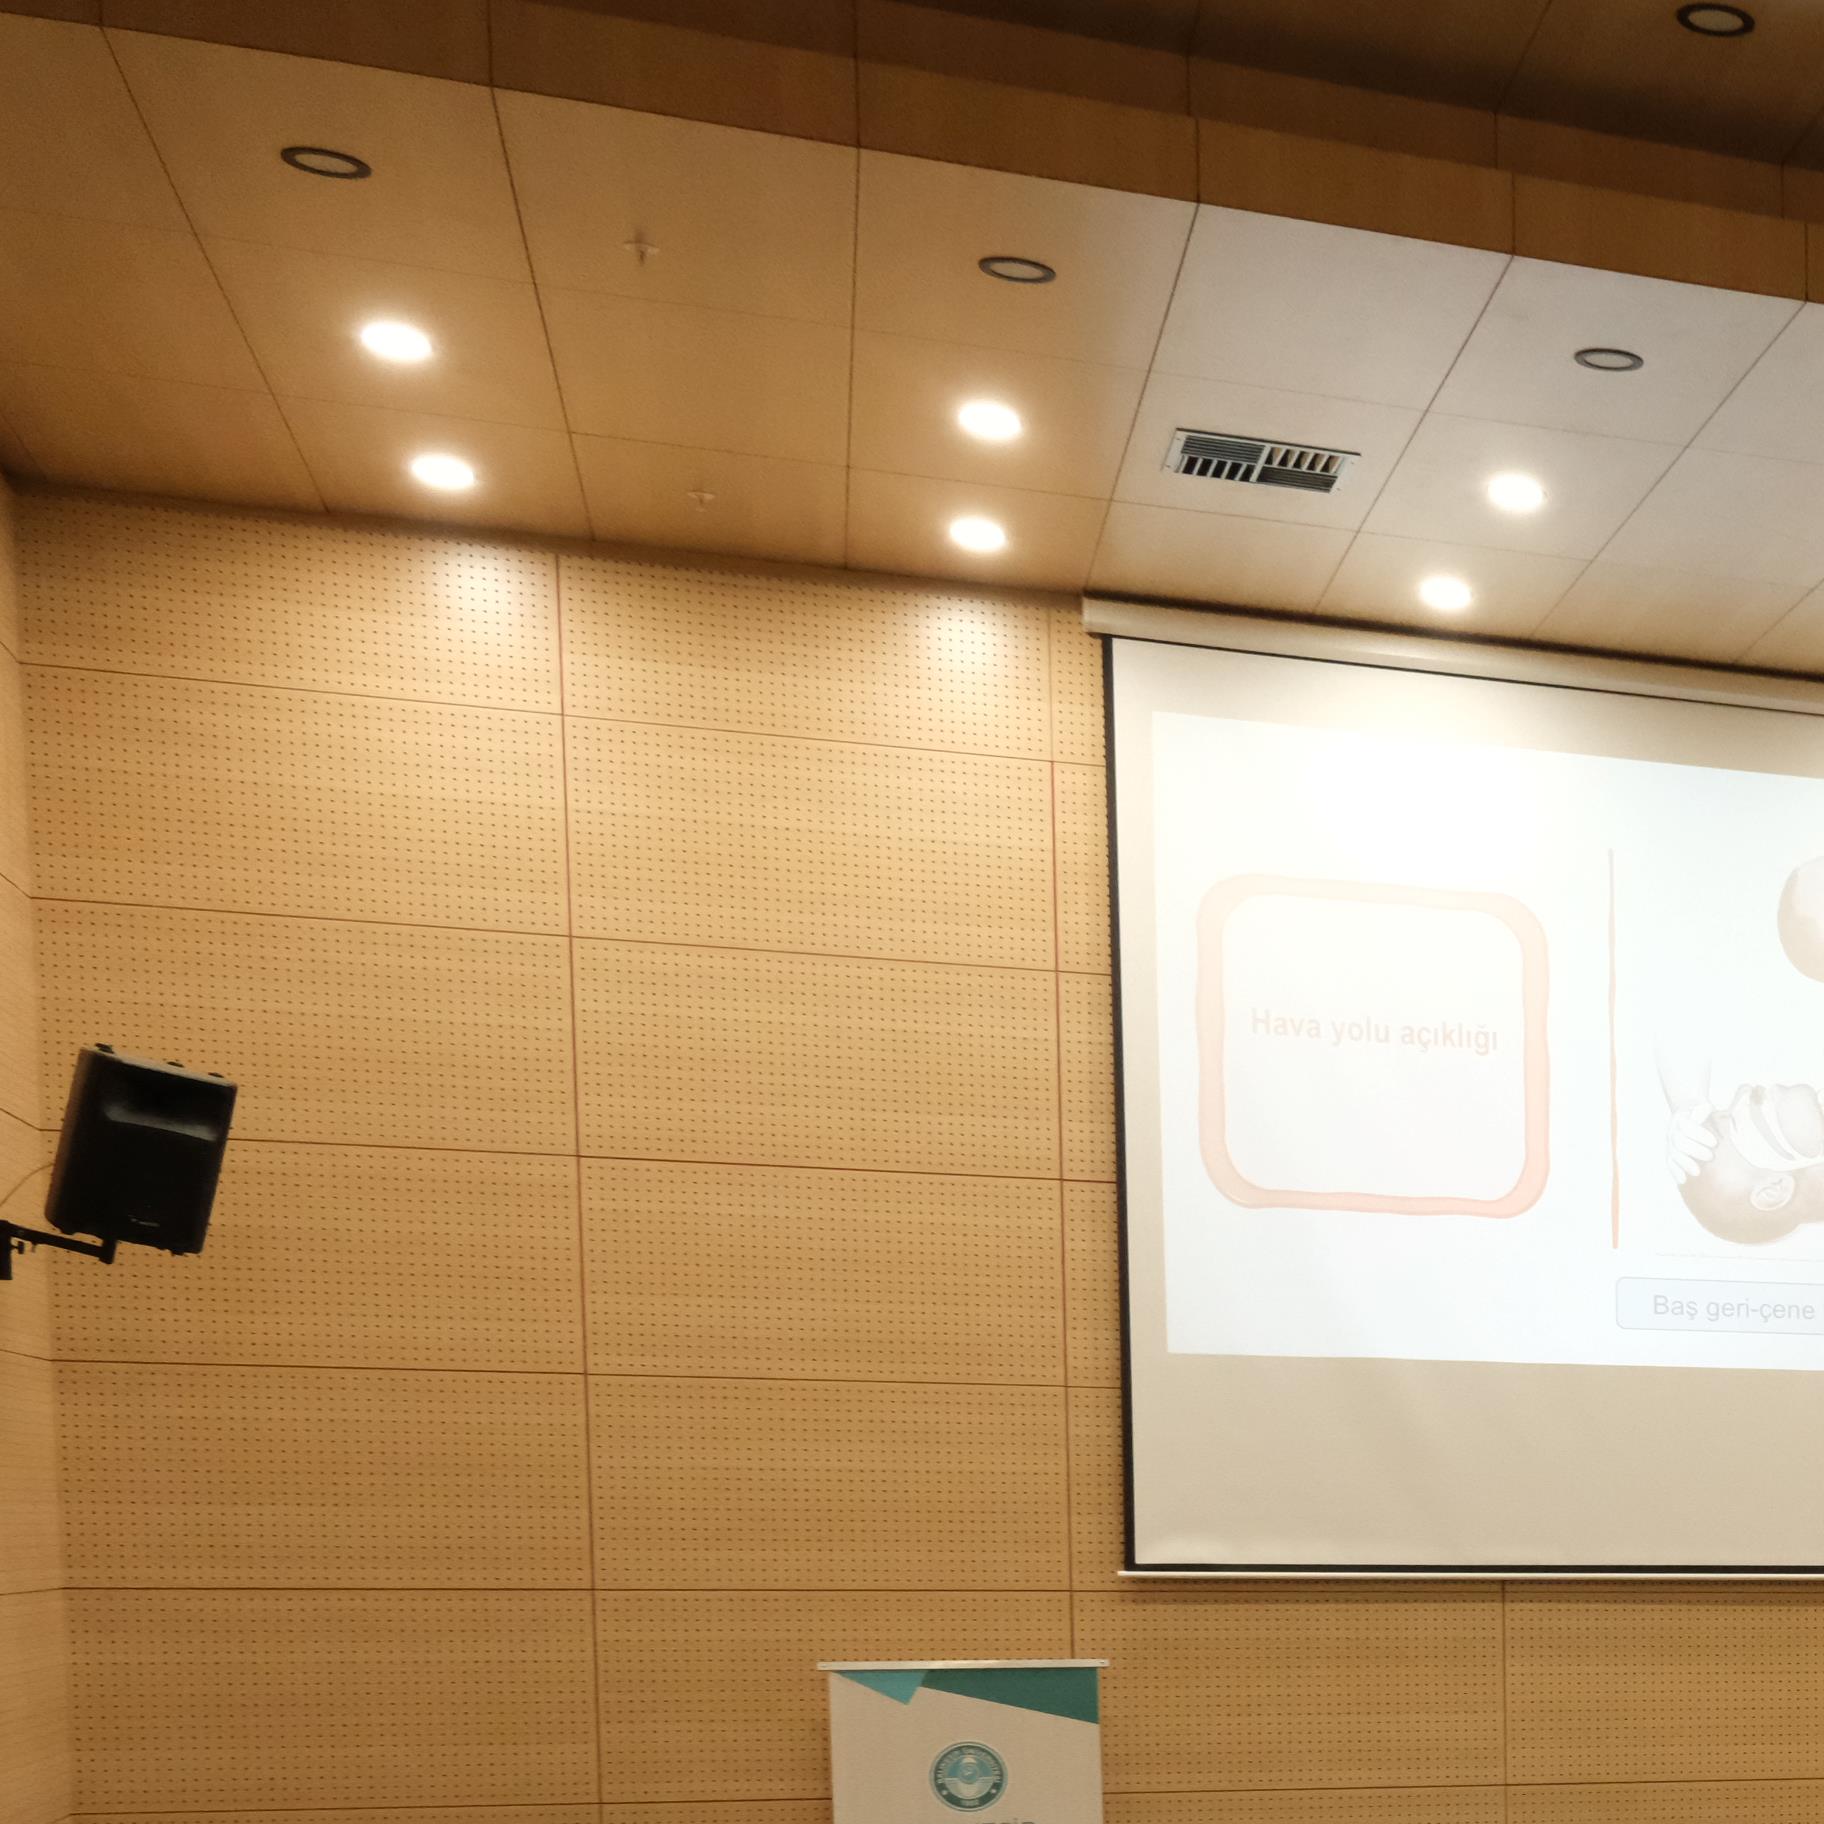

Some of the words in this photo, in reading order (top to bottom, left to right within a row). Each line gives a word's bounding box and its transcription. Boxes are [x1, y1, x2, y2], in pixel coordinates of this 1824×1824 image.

[1249, 1007, 1321, 1037] Hava
[1330, 1015, 1391, 1046] yolu
[1400, 1020, 1498, 1056] açıklığı
[1653, 1294, 1698, 1320] Baş
[1706, 1297, 1816, 1323] geri-çene
